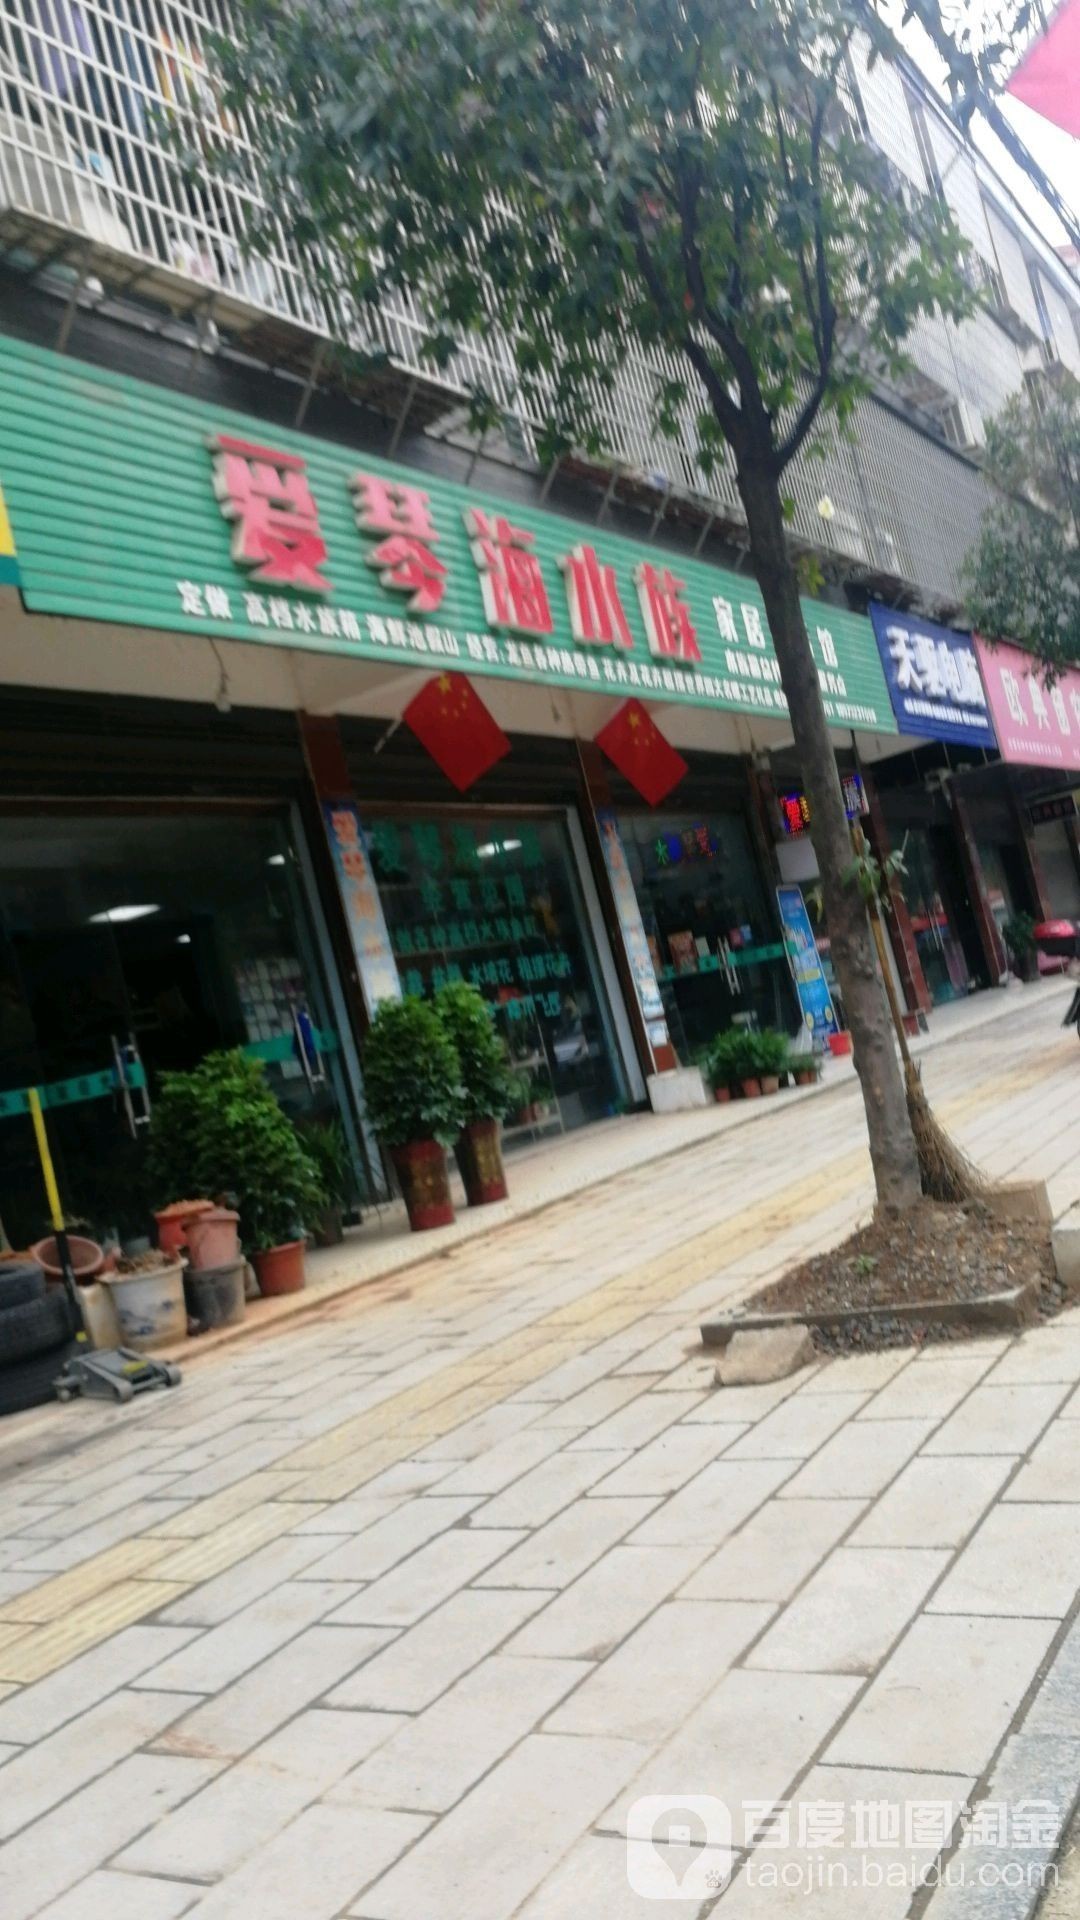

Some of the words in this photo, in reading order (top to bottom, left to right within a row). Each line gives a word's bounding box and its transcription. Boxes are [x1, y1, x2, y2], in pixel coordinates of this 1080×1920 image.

[178, 580, 231, 618] 定做
[210, 434, 703, 662] 爱琴海水族
